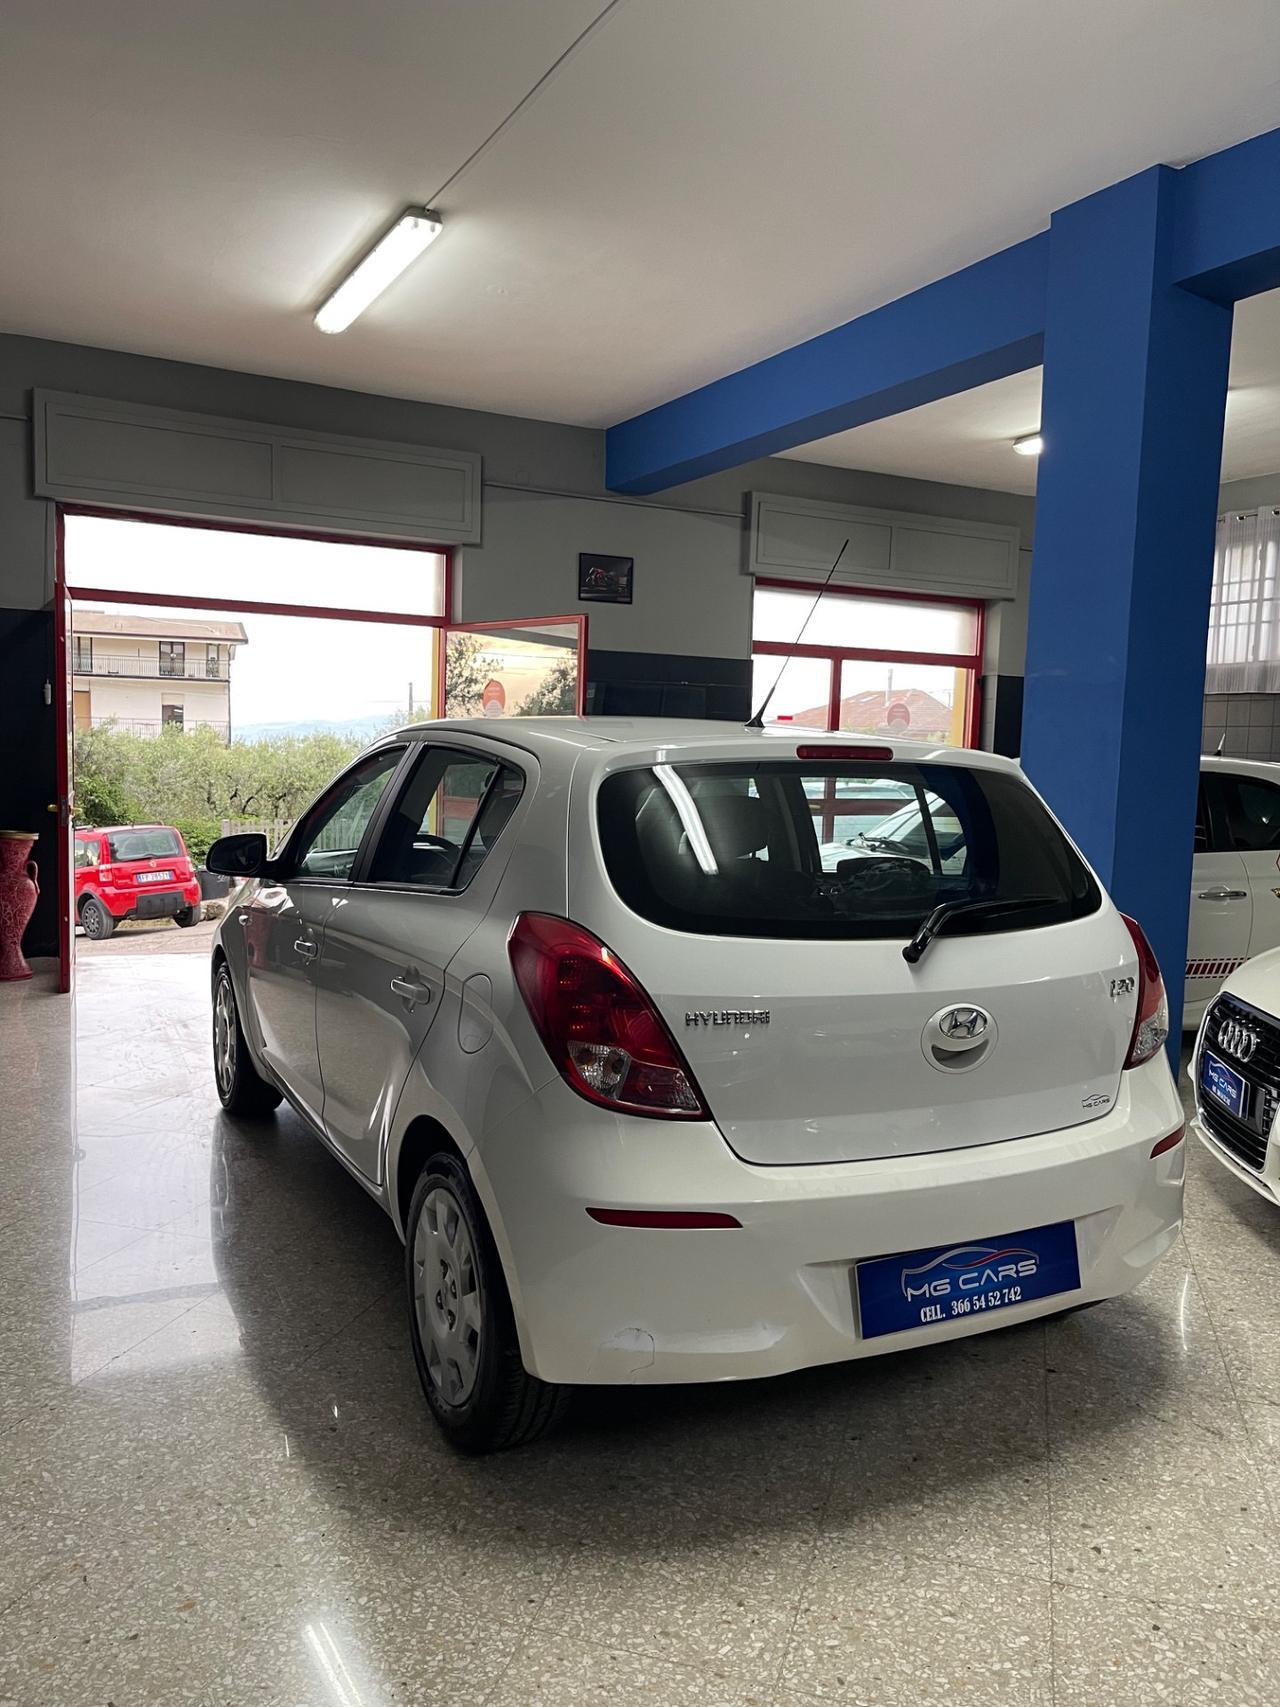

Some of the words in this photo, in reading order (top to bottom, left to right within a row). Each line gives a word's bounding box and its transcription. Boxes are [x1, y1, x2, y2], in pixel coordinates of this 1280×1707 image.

[685, 1010, 770, 1026] HYUNDAI
[1219, 1078, 1237, 1099] CARS
[906, 1278, 951, 1302] MG
[958, 1259, 1037, 1290] CARS
[920, 1304, 946, 1322] CELL.
[951, 1297, 971, 1315] 366
[973, 1295, 986, 1310] 54
[988, 1292, 1001, 1307] 52
[1002, 1286, 1022, 1304] 742
